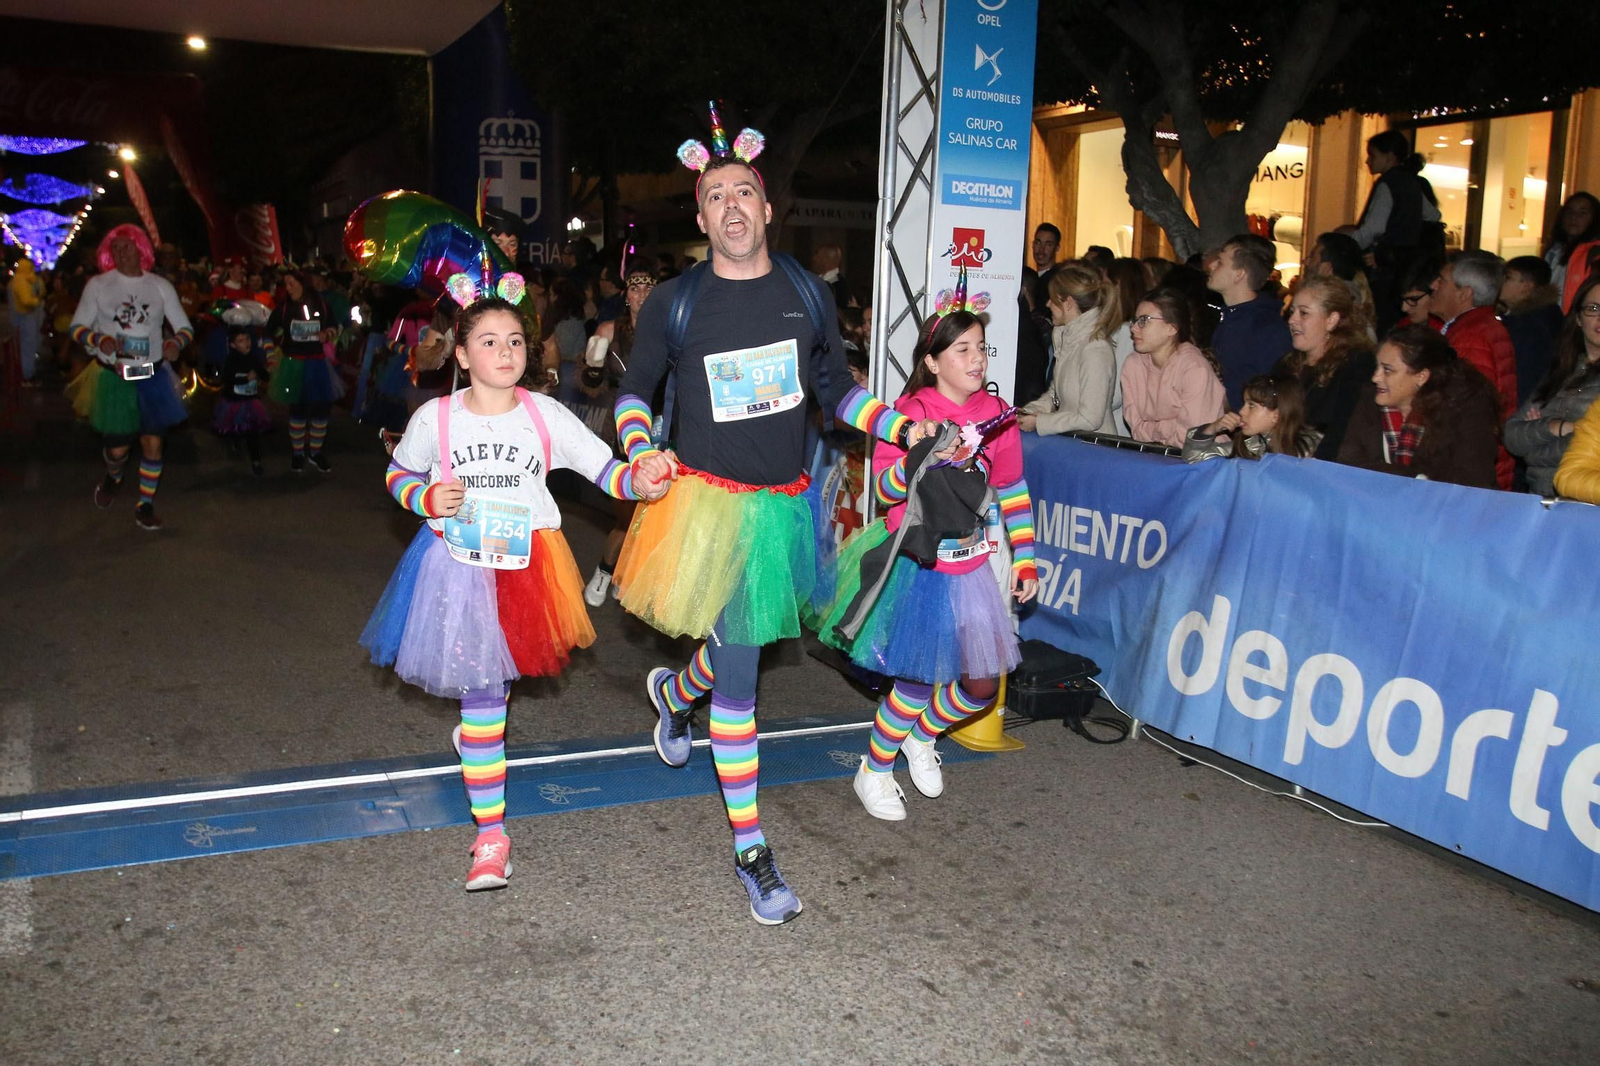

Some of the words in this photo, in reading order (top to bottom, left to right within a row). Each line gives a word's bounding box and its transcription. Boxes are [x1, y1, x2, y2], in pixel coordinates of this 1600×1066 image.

[977, 14, 1001, 27] OPEL
[952, 87, 963, 98] DS
[966, 90, 1021, 105] AUTOMOBILES
[966, 117, 1003, 132] GRUPO
[948, 132, 993, 149] SALINAS
[996, 137, 1017, 151] CAR
[951, 180, 1013, 199] DECATHLON
[522, 237, 562, 265] RÍA
[751, 362, 787, 386] 971
[478, 517, 526, 541] 1254
